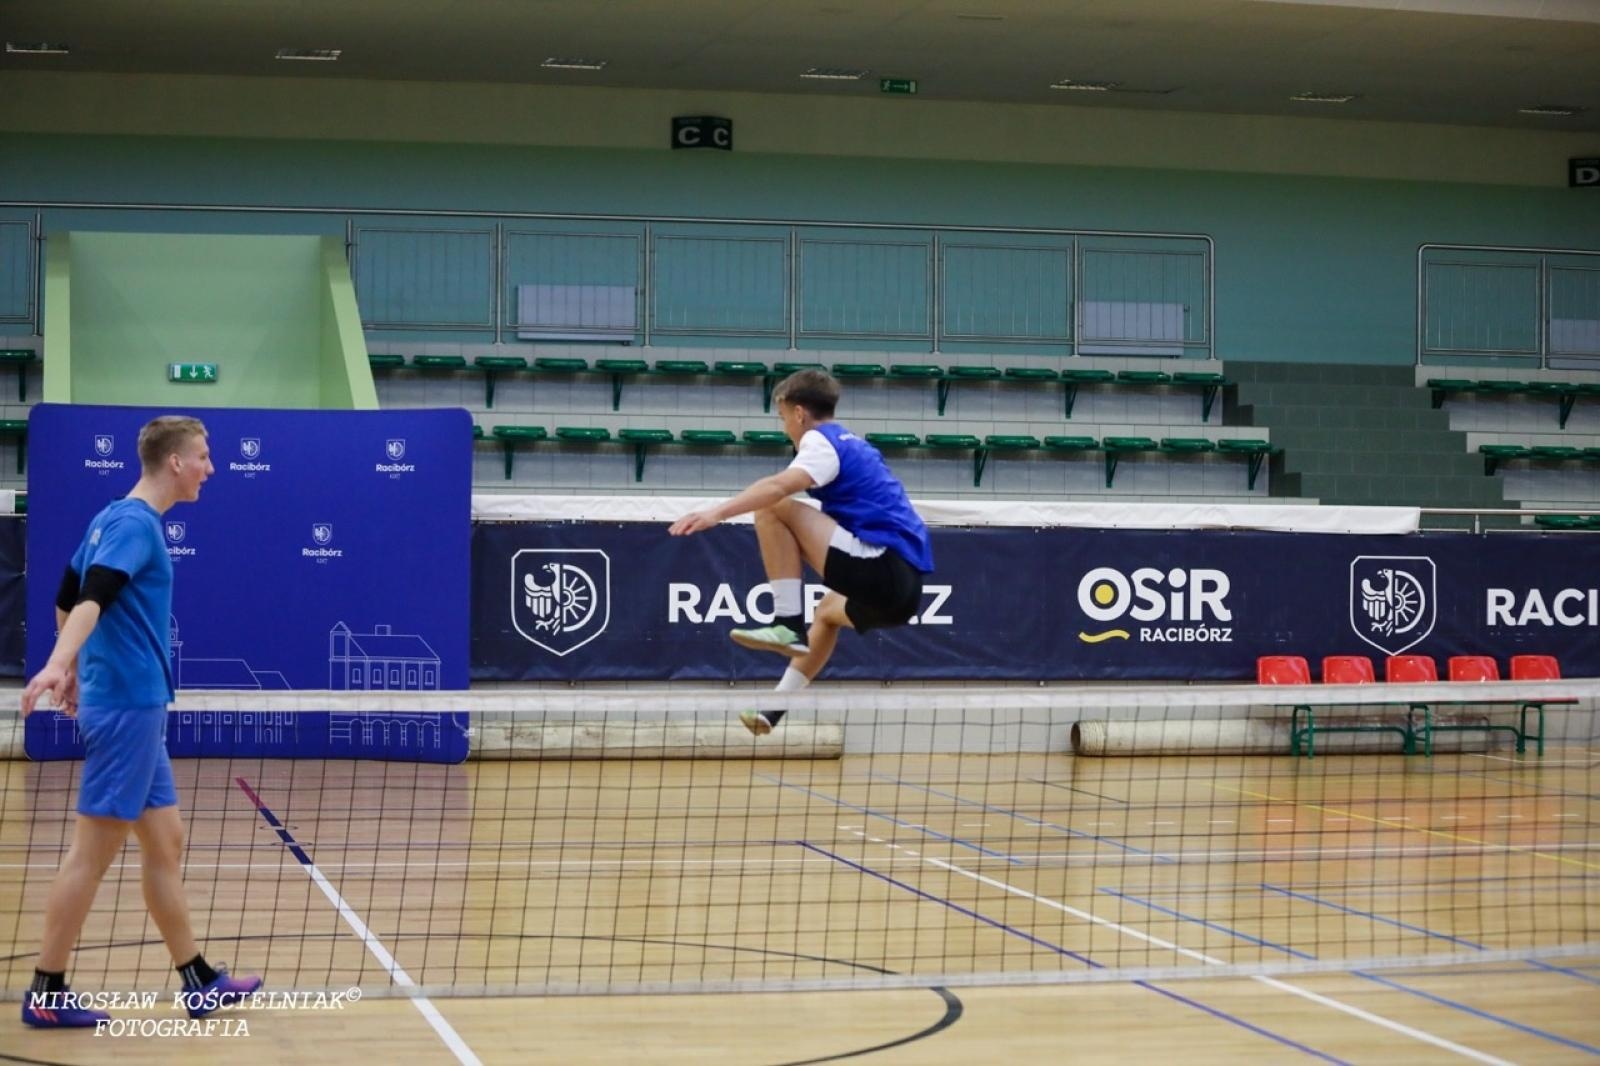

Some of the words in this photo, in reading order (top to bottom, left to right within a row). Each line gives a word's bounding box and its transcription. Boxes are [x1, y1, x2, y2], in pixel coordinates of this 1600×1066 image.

[678, 126, 701, 145] C
[713, 127, 729, 146] C
[1575, 167, 1600, 184] D
[84, 459, 124, 468] Racibórz
[229, 461, 271, 471] Racibórz
[375, 463, 415, 472] Racibórz
[167, 546, 196, 556] cibórz
[302, 547, 342, 557] Racibórz
[668, 583, 954, 625] RACBZ
[1486, 588, 1599, 627] RACI
[1139, 623, 1233, 643] RACIBÓRZ
